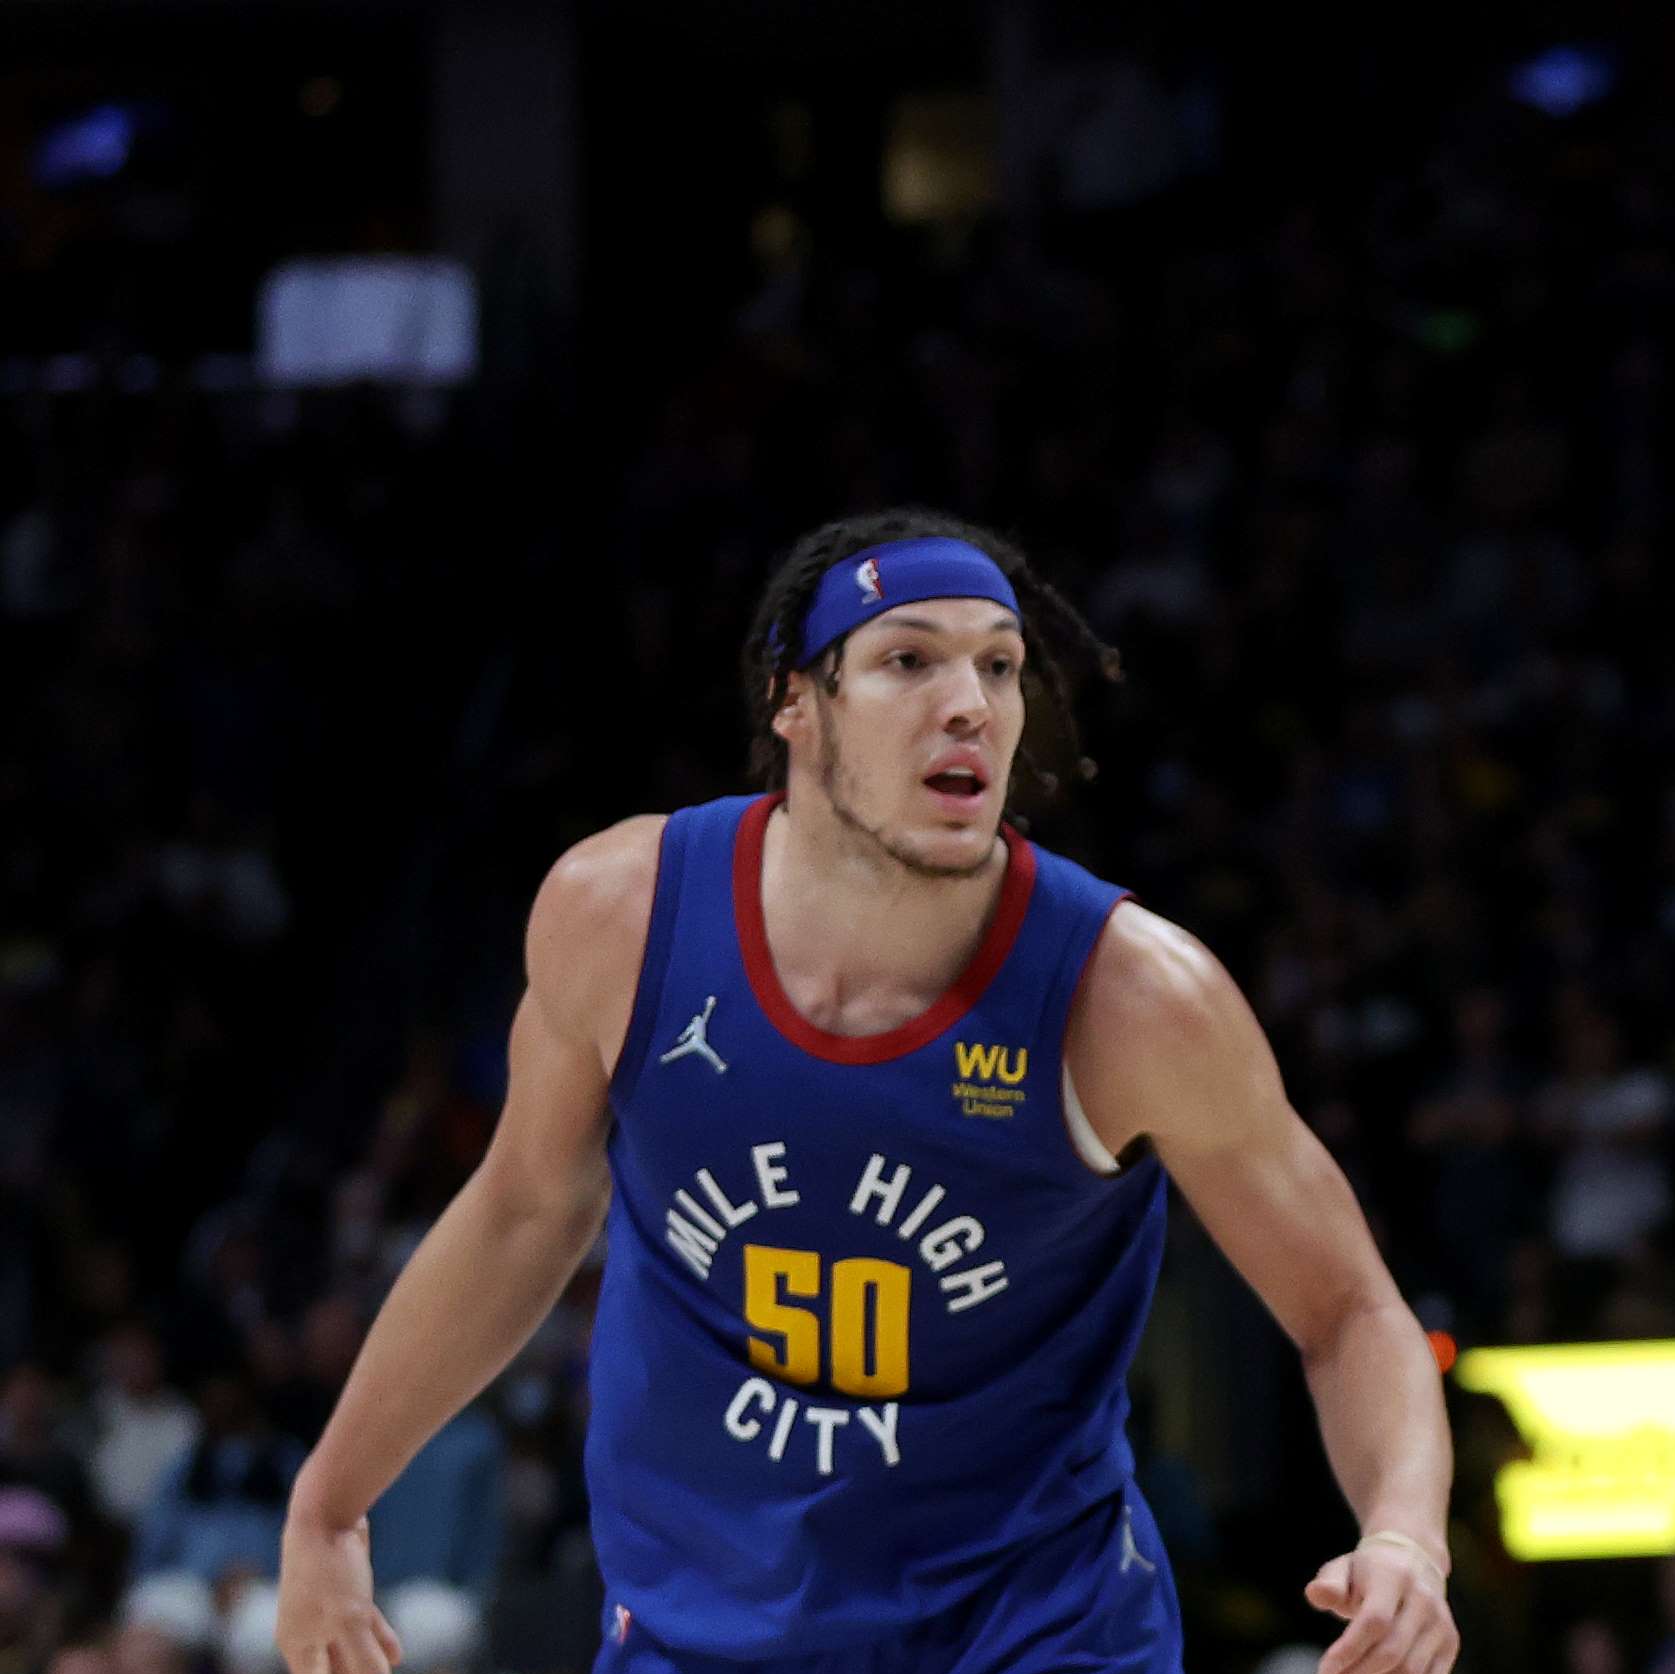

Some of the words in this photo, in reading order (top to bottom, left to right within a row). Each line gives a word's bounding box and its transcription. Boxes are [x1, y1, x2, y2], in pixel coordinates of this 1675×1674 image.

[954, 1041, 1028, 1085] WU
[665, 1141, 800, 1280] MILE
[849, 1153, 1009, 1313] HIGH
[743, 1243, 911, 1398] 50
[724, 1376, 901, 1475] CITY
